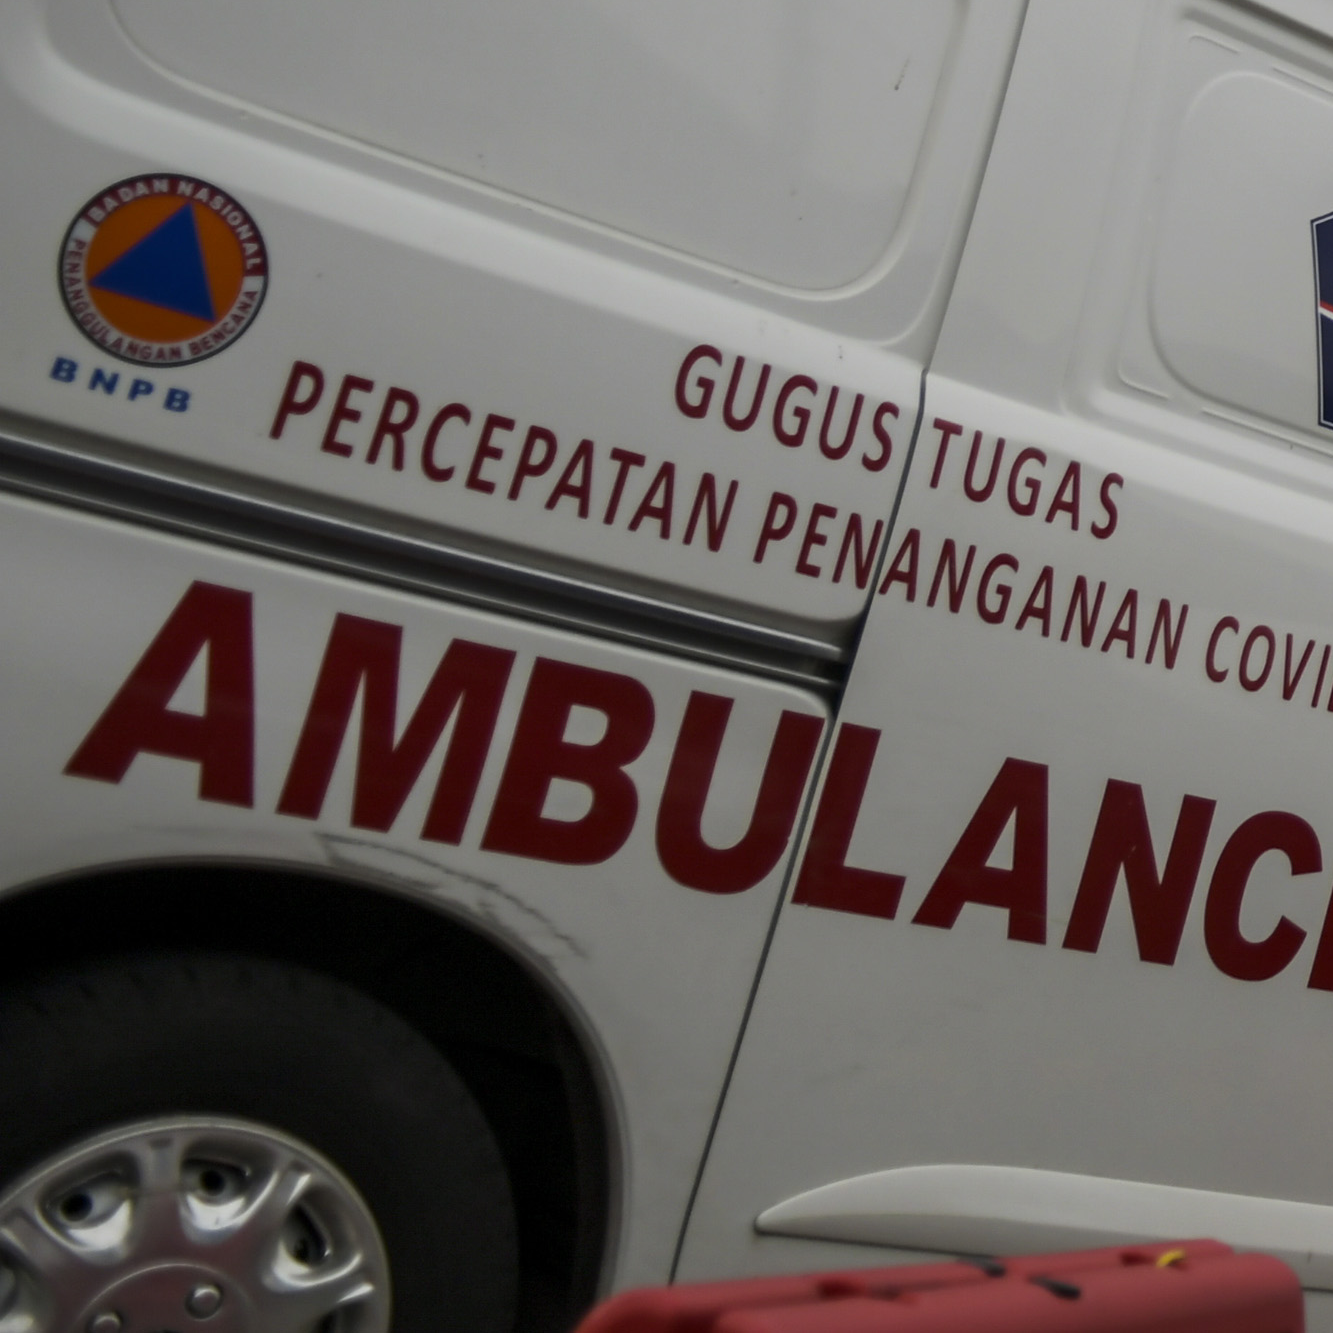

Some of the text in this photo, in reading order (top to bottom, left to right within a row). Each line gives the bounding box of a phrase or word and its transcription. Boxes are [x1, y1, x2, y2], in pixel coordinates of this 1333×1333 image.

[88, 179, 262, 269] BADAN NASIONAL
[65, 238, 258, 361] PENANGGULANGAN BENCANA
[49, 356, 192, 413] BNPB
[673, 344, 1124, 540] GUGUS TUGAS
[268, 360, 739, 553] PERCEPATAN
[752, 491, 1190, 670] PENANGANAN
